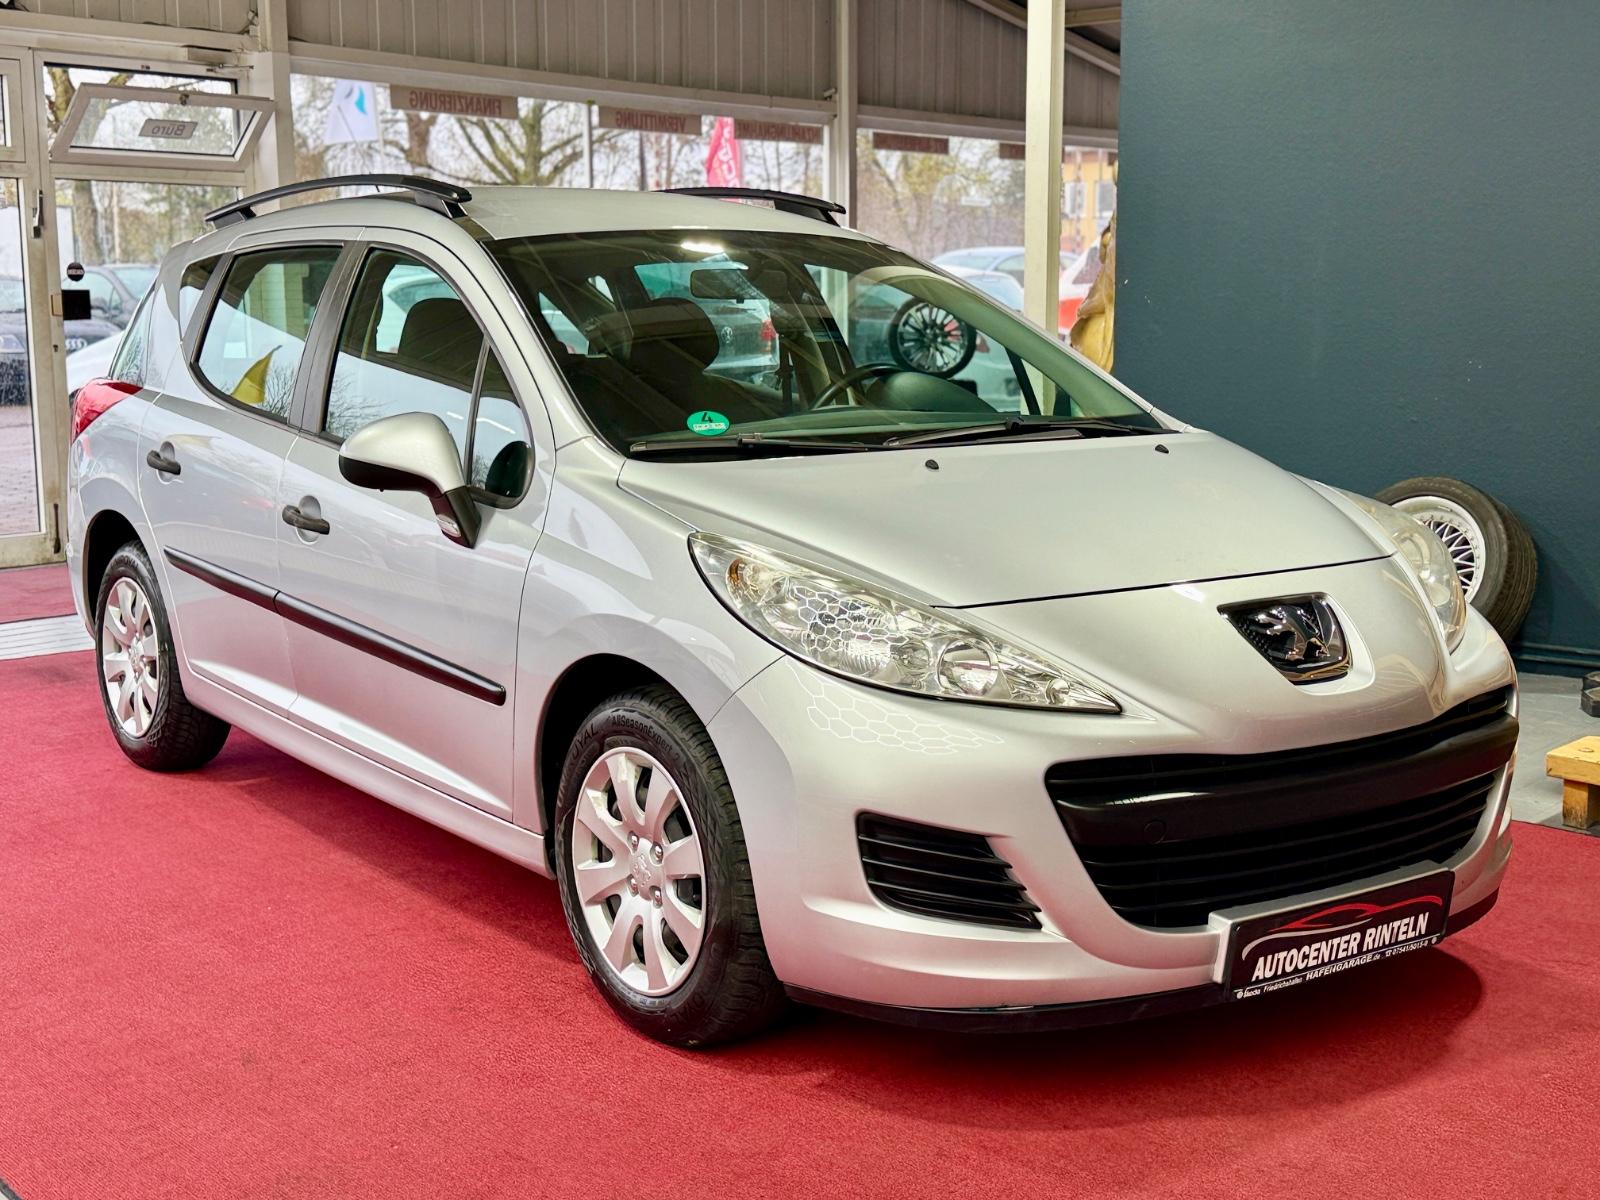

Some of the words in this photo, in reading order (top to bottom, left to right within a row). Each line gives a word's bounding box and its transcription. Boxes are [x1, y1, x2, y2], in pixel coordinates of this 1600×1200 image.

[701, 412, 713, 423] 4
[1251, 932, 1361, 982] AUTOCENTER
[1362, 911, 1430, 952] RINTELN
